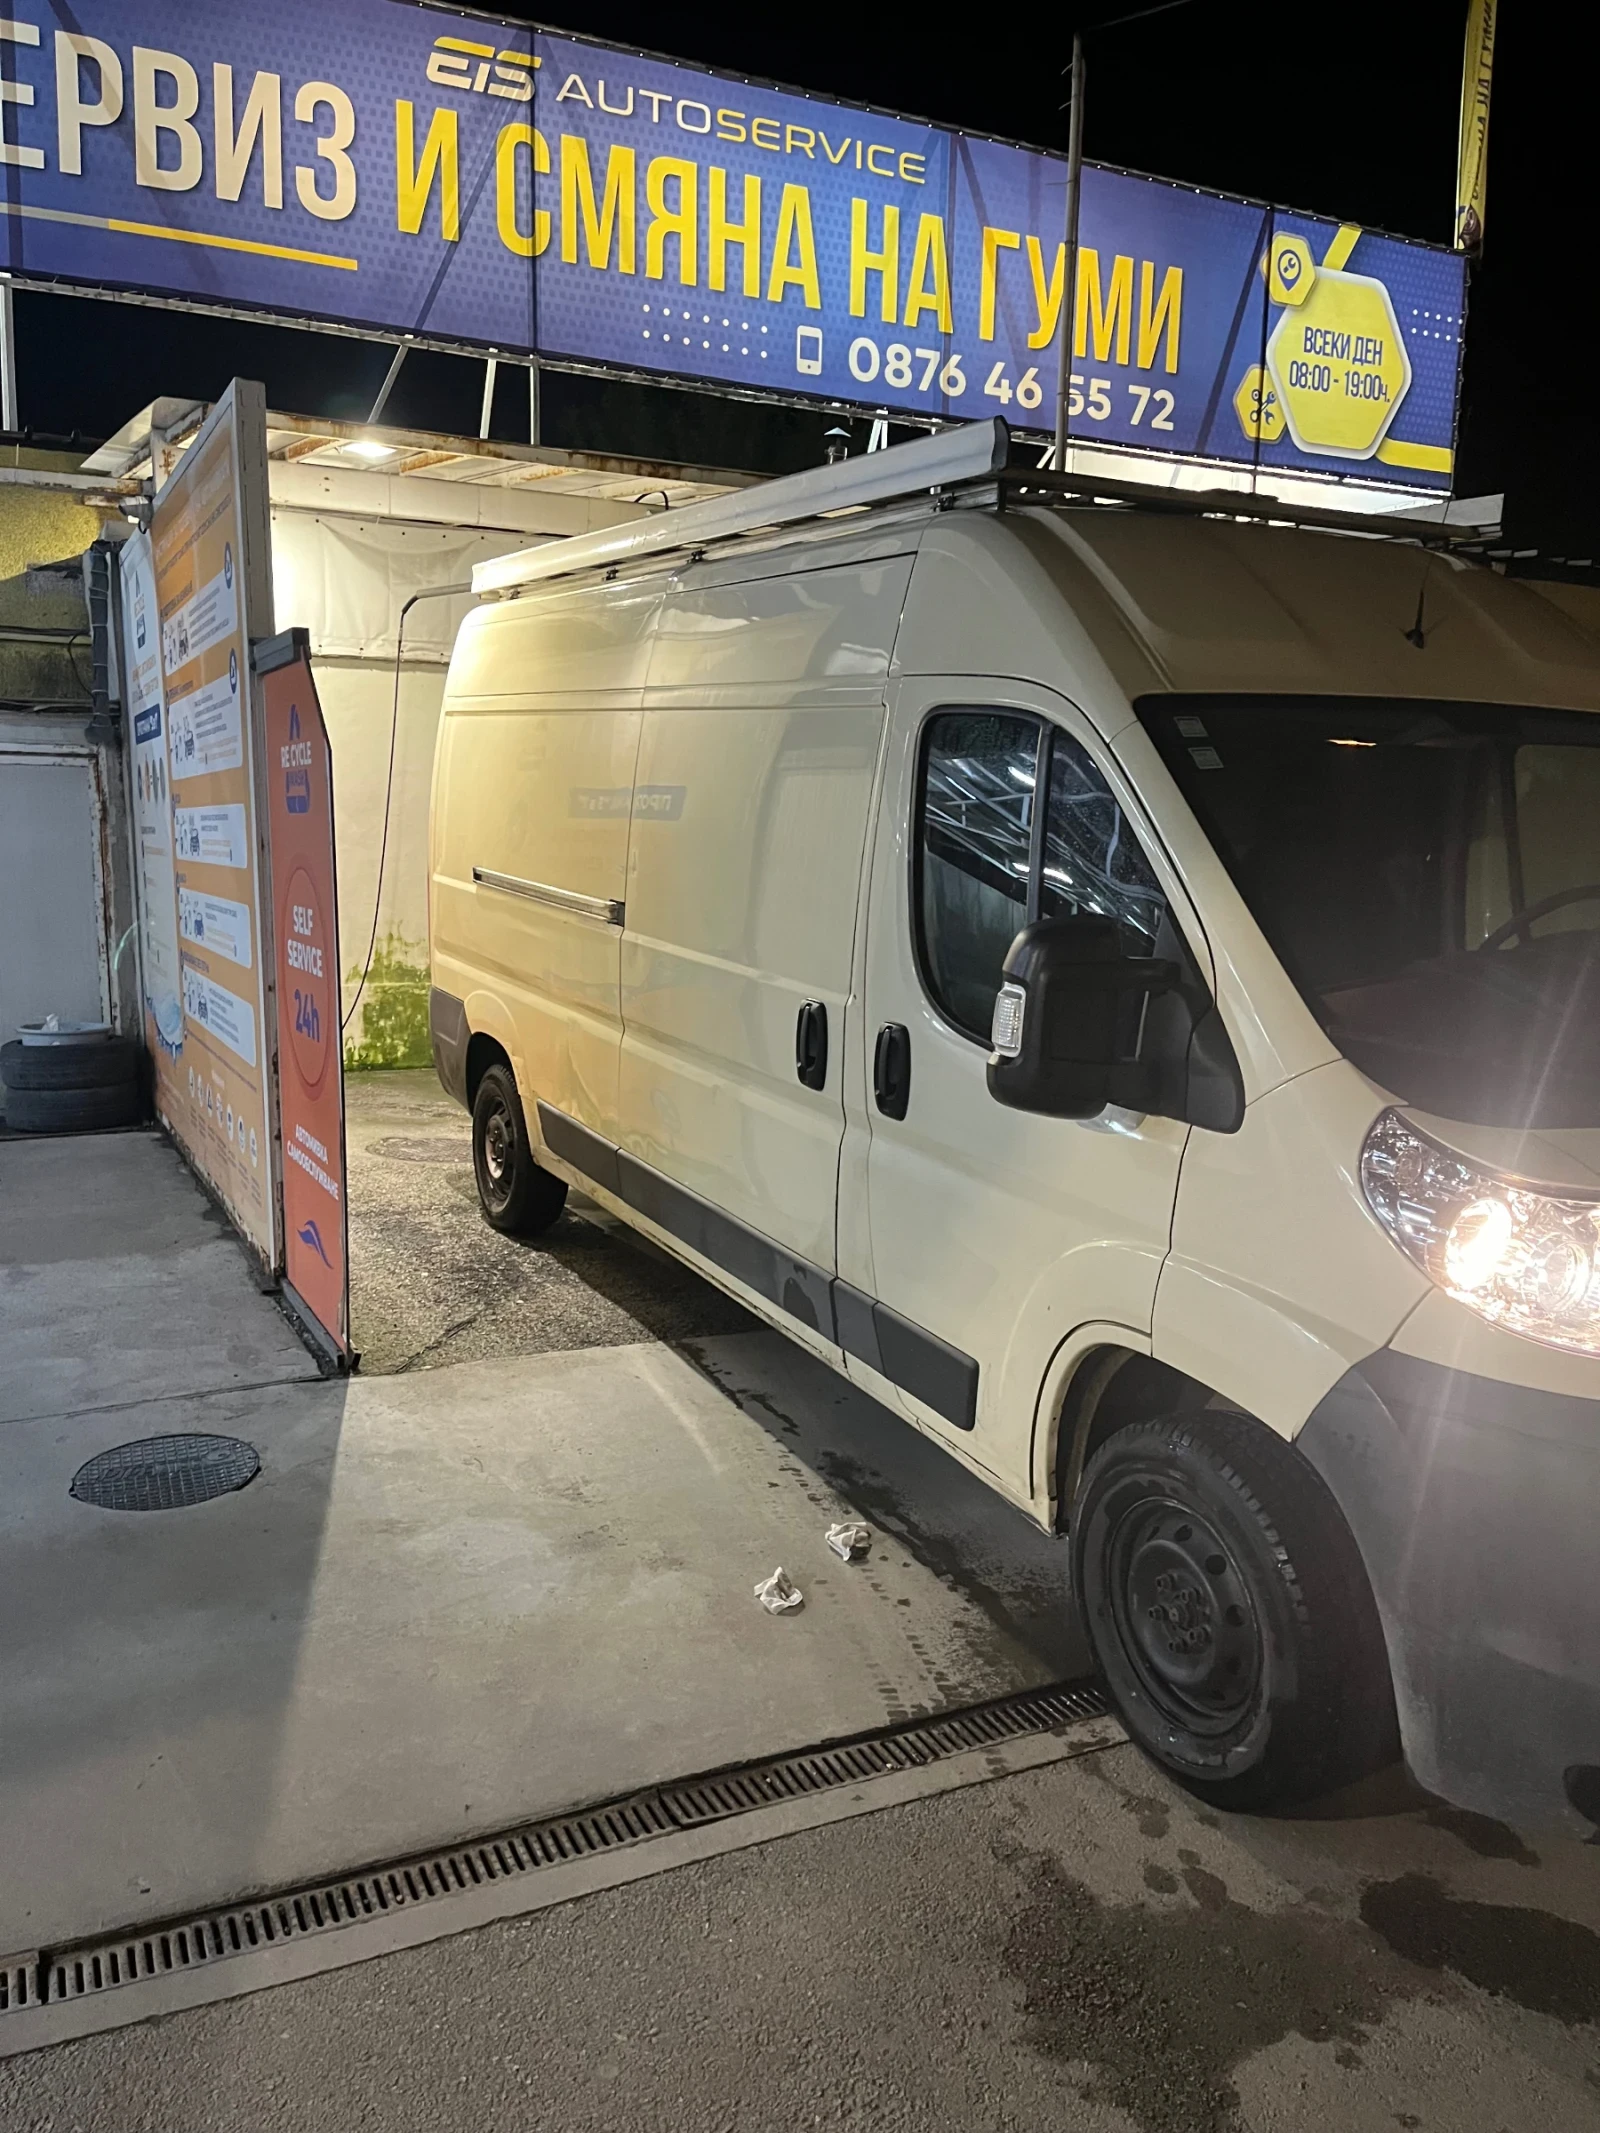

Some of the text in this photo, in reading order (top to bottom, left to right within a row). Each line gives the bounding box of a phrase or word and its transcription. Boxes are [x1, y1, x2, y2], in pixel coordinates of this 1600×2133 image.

[555, 73, 926, 185] AUTOSERVICE
[0, 20, 1183, 374] ЕРВИЗ И СМЯНА НА ГУМИ
[1303, 326, 1383, 366] ВСЕКИ ДЕН
[848, 336, 1176, 431] 0876 46 55 72
[1289, 360, 1331, 393] 08:00
[293, 904, 313, 936] SELF
[287, 938, 323, 978] SERVICE
[294, 988, 320, 1043] 24h
